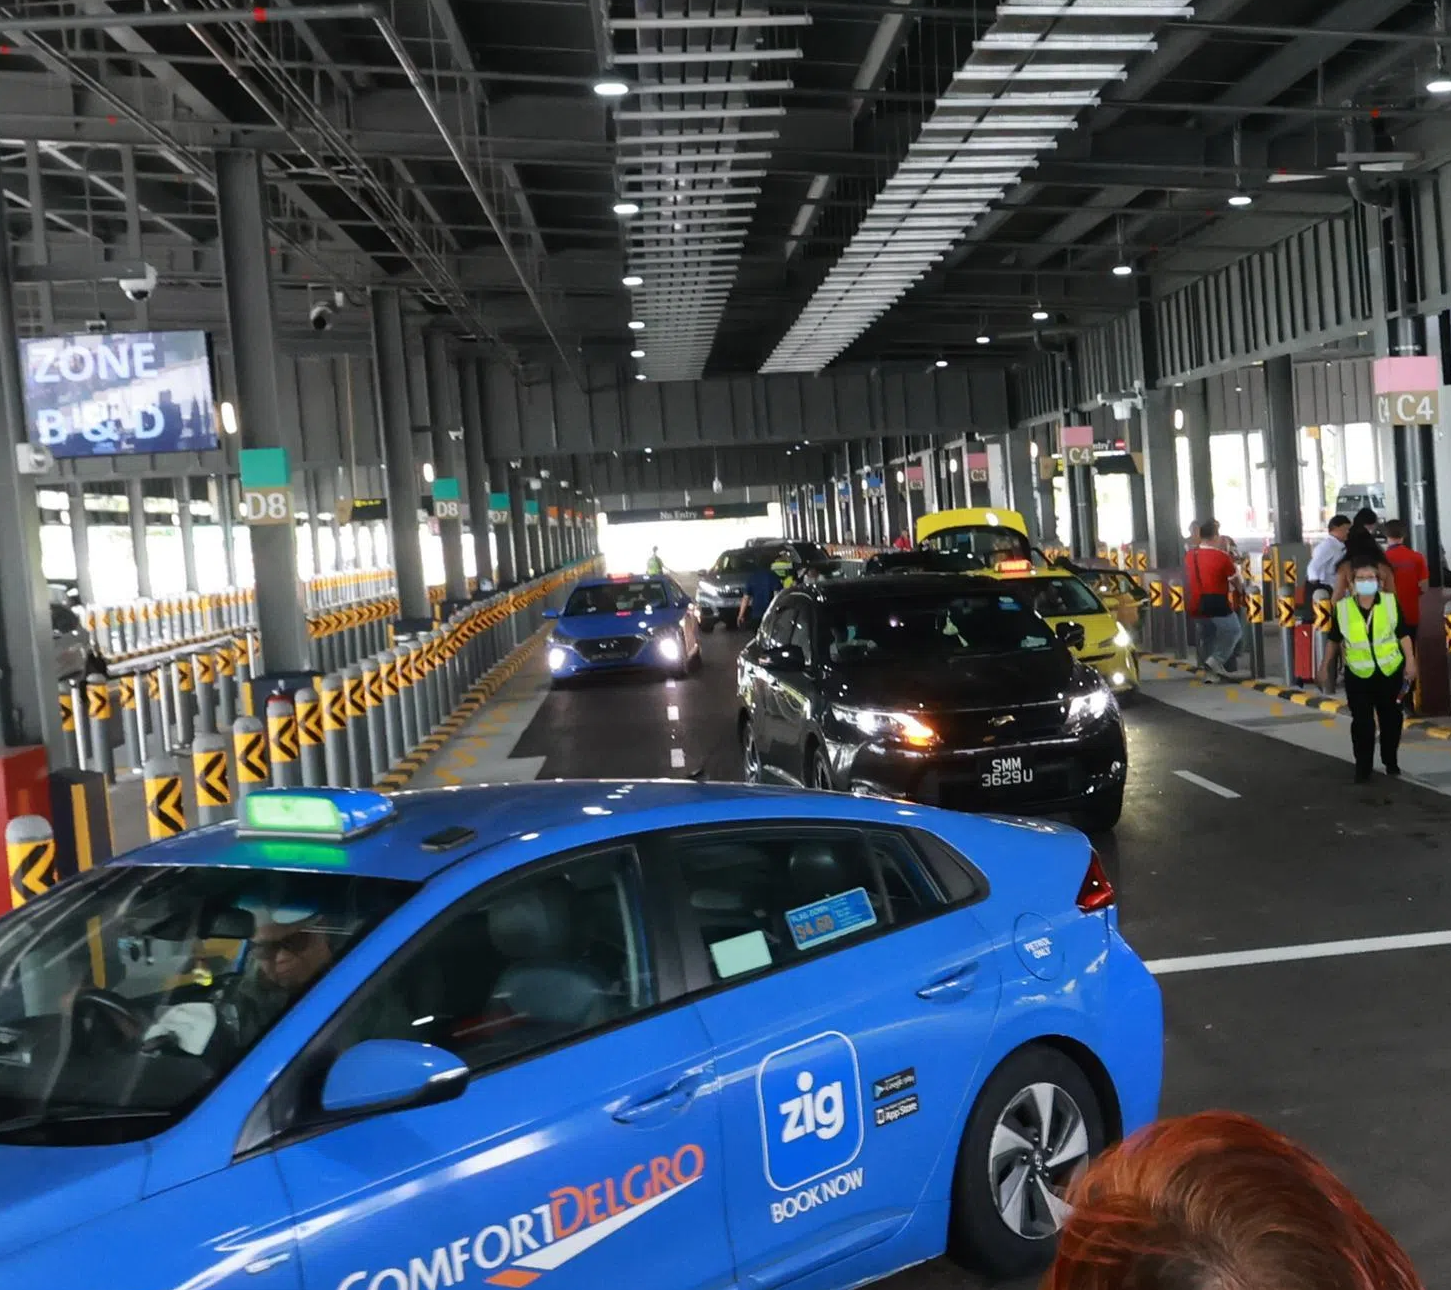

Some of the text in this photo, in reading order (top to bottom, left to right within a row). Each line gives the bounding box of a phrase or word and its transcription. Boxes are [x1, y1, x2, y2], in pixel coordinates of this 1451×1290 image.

[28, 342, 159, 383] ZONE
[1397, 394, 1435, 422] C4
[37, 408, 68, 445] B
[133, 403, 165, 440] D
[1069, 446, 1091, 464] C4
[245, 491, 288, 520] D8
[435, 500, 459, 518] D8
[981, 768, 1034, 788] 3629U
[991, 756, 1022, 773] SMM
[779, 1071, 845, 1144] zig
[769, 1167, 865, 1224] BOOK NOW
